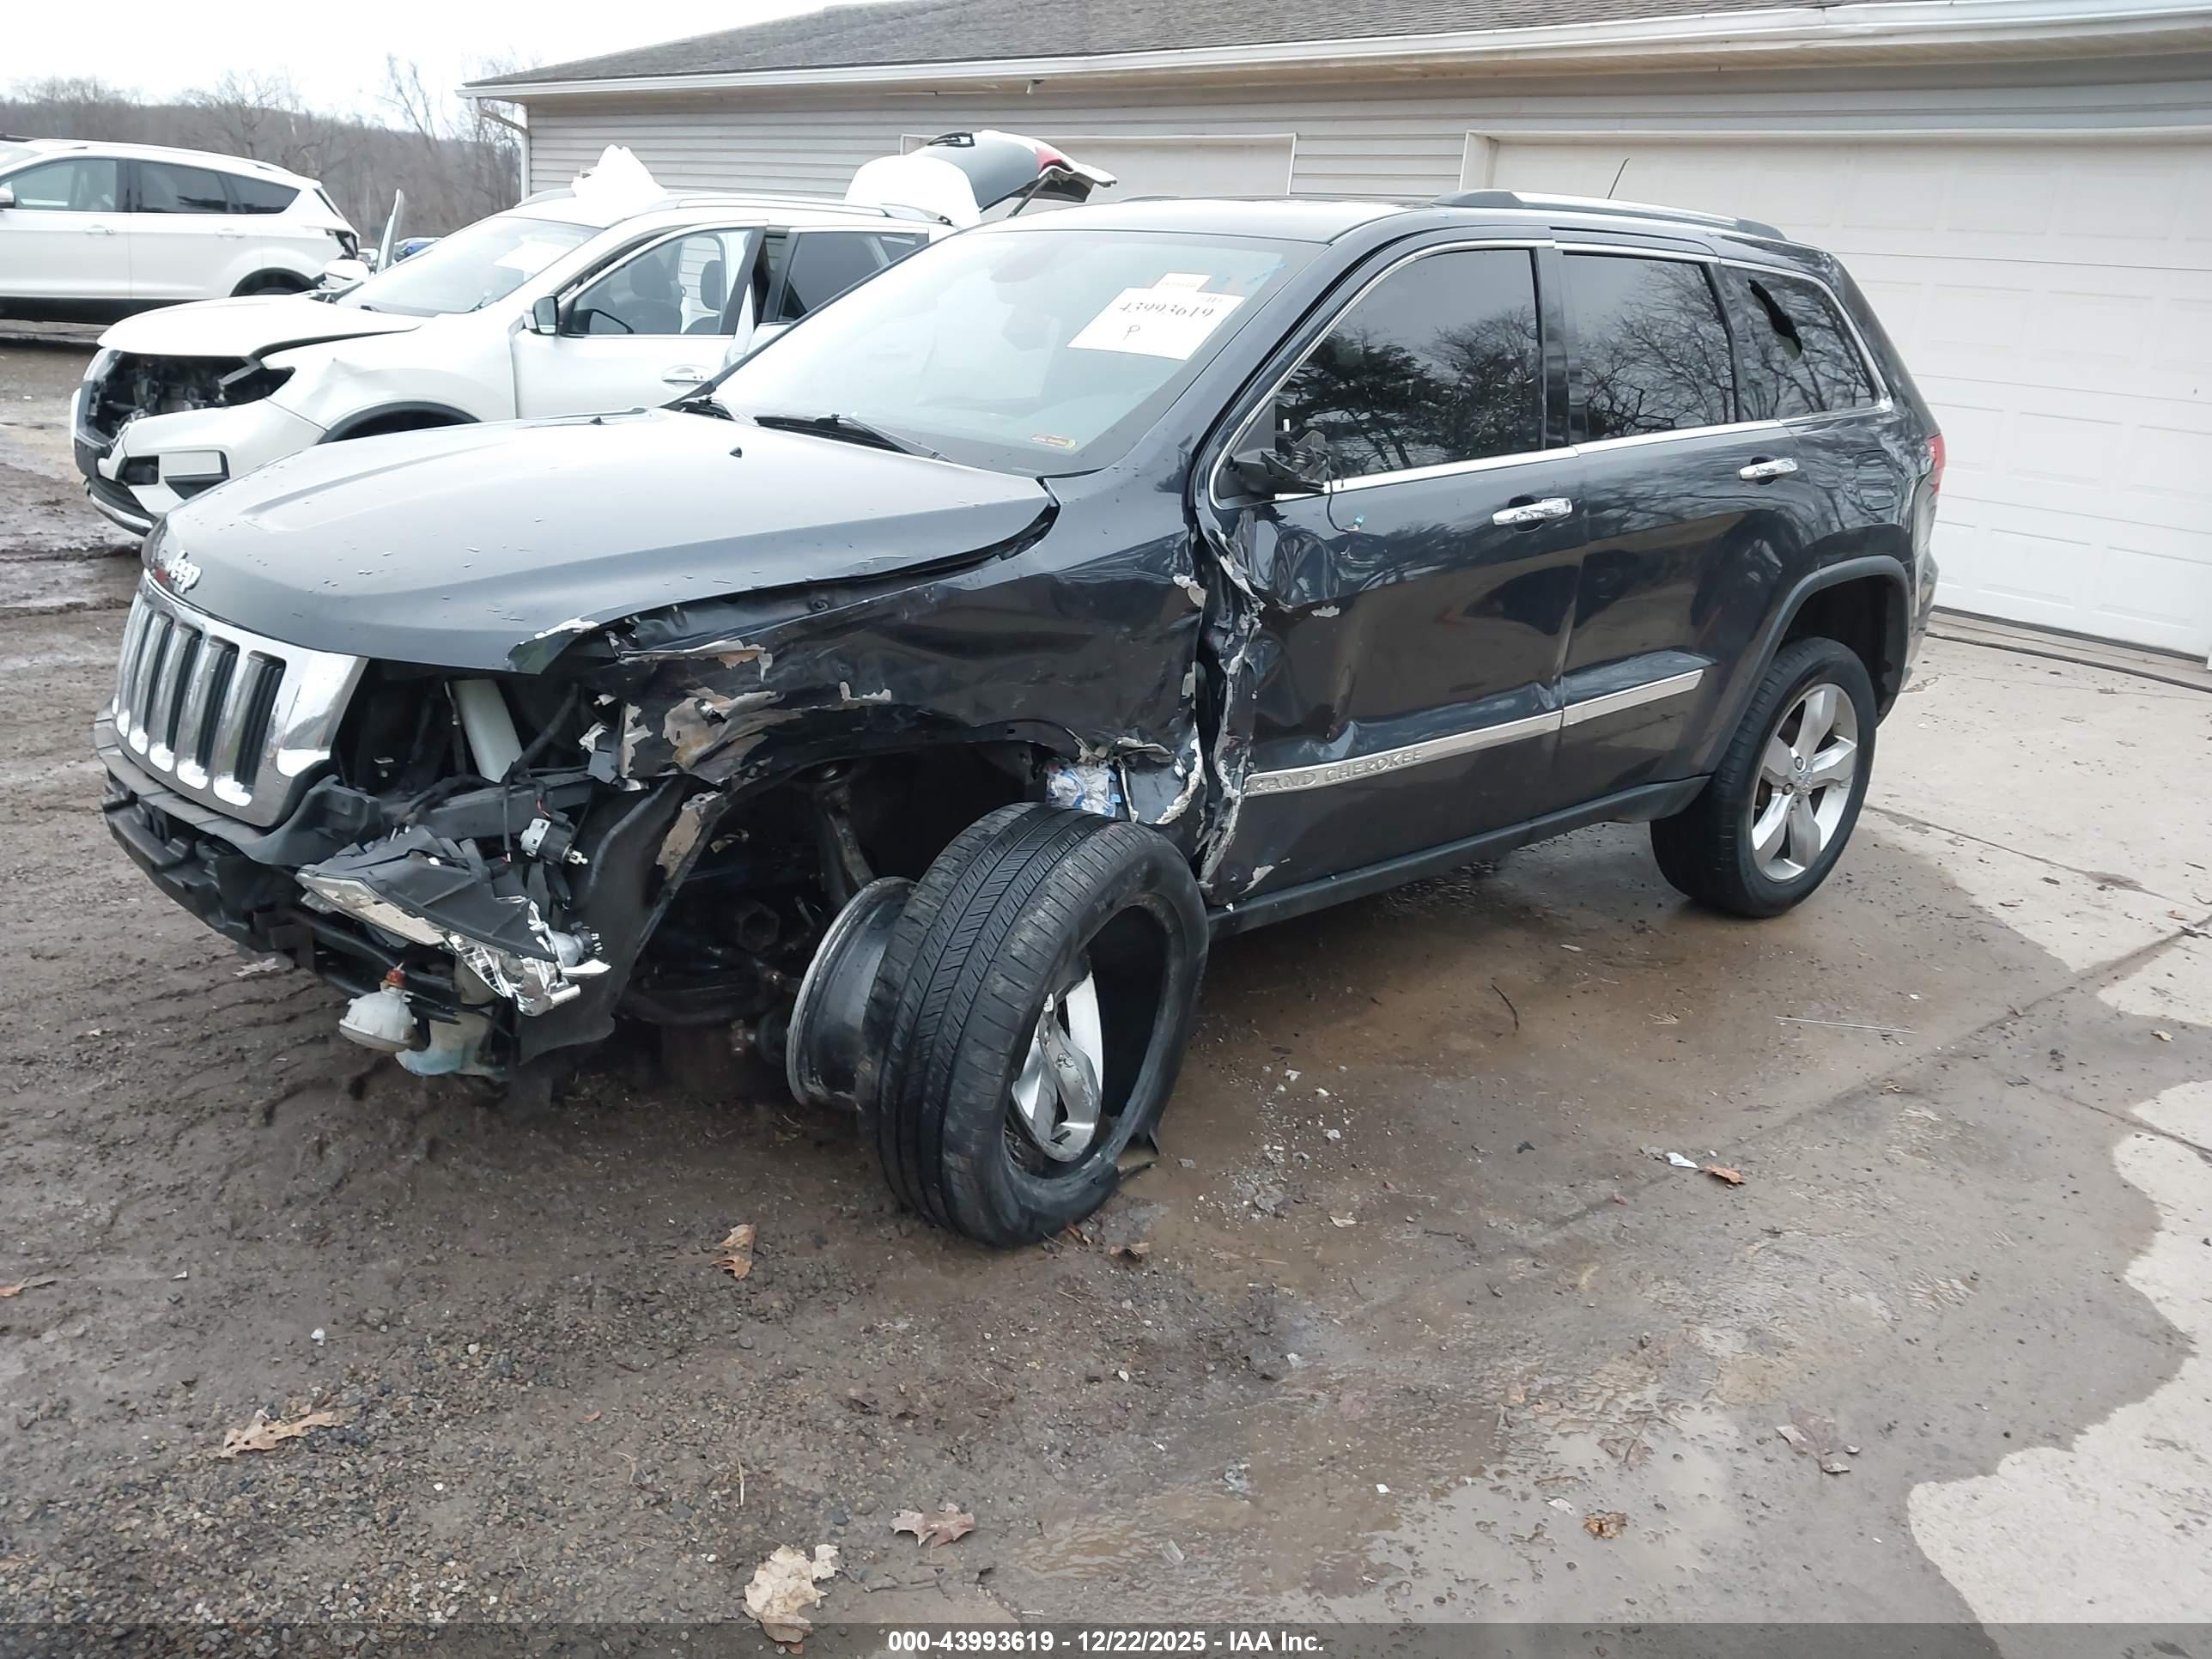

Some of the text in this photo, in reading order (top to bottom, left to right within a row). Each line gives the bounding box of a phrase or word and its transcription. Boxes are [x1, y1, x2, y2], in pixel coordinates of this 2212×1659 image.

[167, 550, 202, 593] Jeep
[1245, 750, 1422, 793] RAND CHEROKEE
